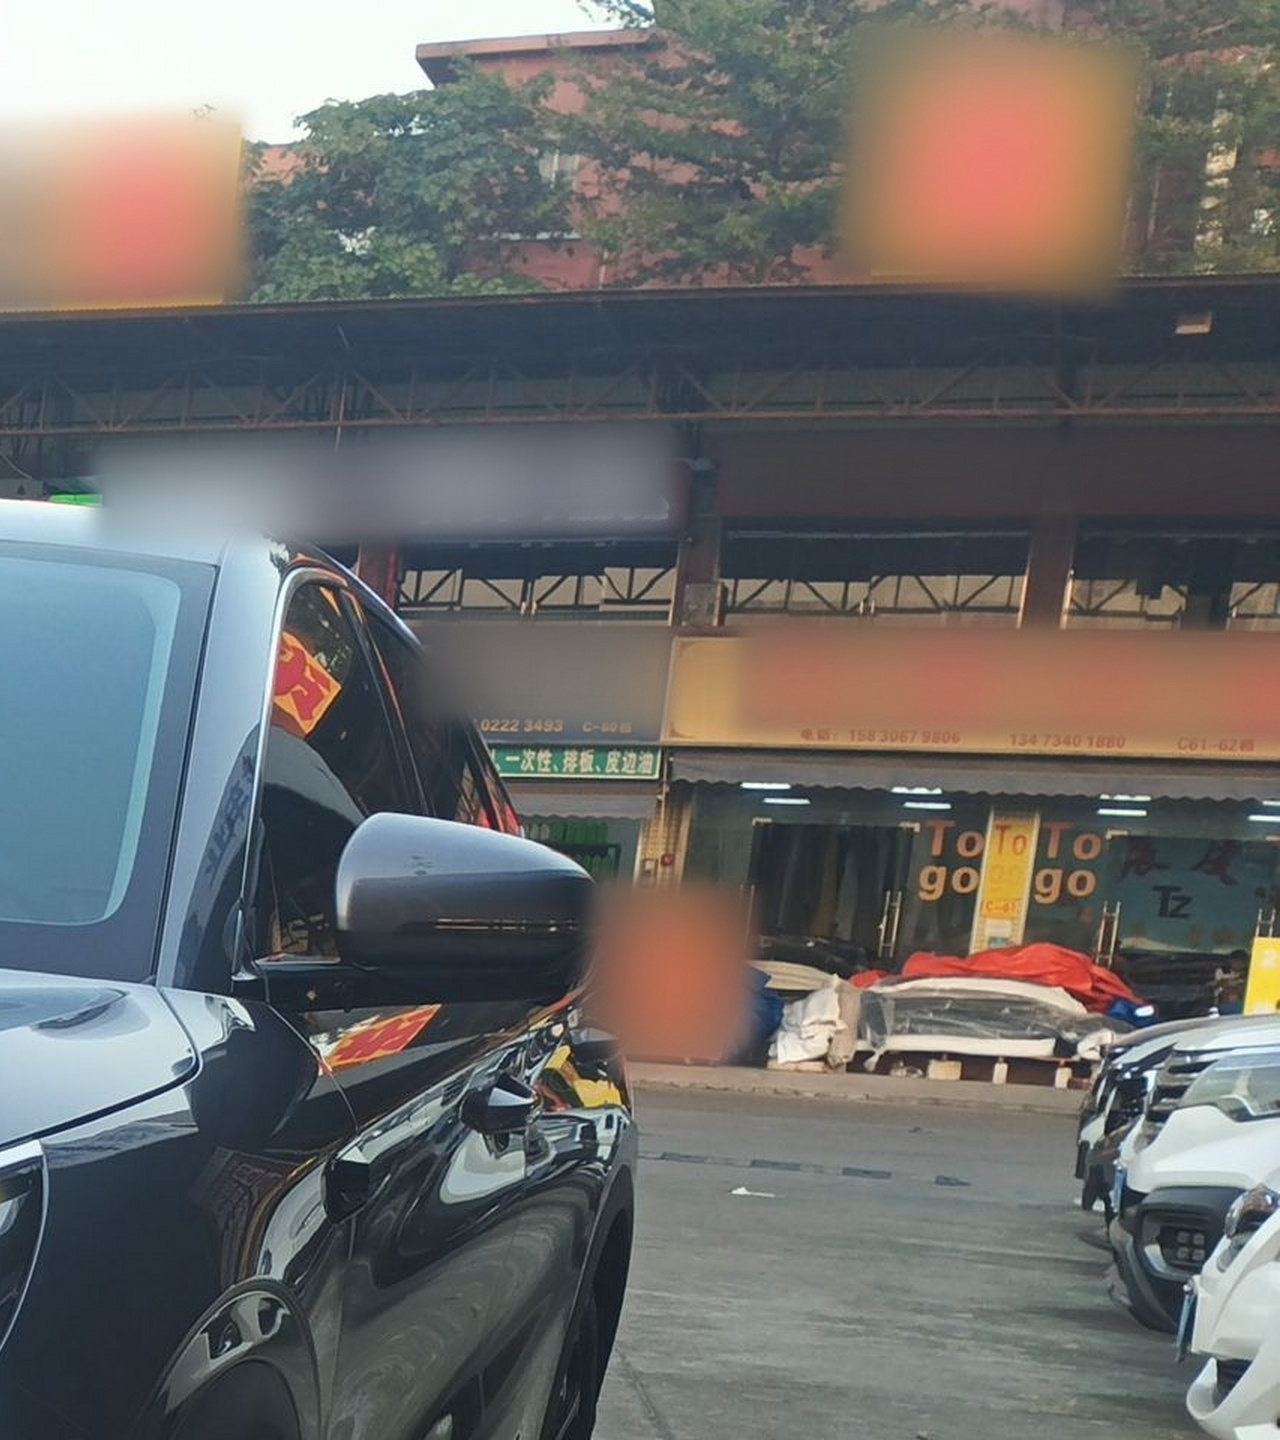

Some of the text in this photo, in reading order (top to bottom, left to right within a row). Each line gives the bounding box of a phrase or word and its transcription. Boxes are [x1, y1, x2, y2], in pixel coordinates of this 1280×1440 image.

[927, 819, 985, 858] To
[994, 822, 1028, 857] To
[1042, 820, 1102, 861] To
[918, 864, 980, 902] go
[1034, 867, 1097, 905] go
